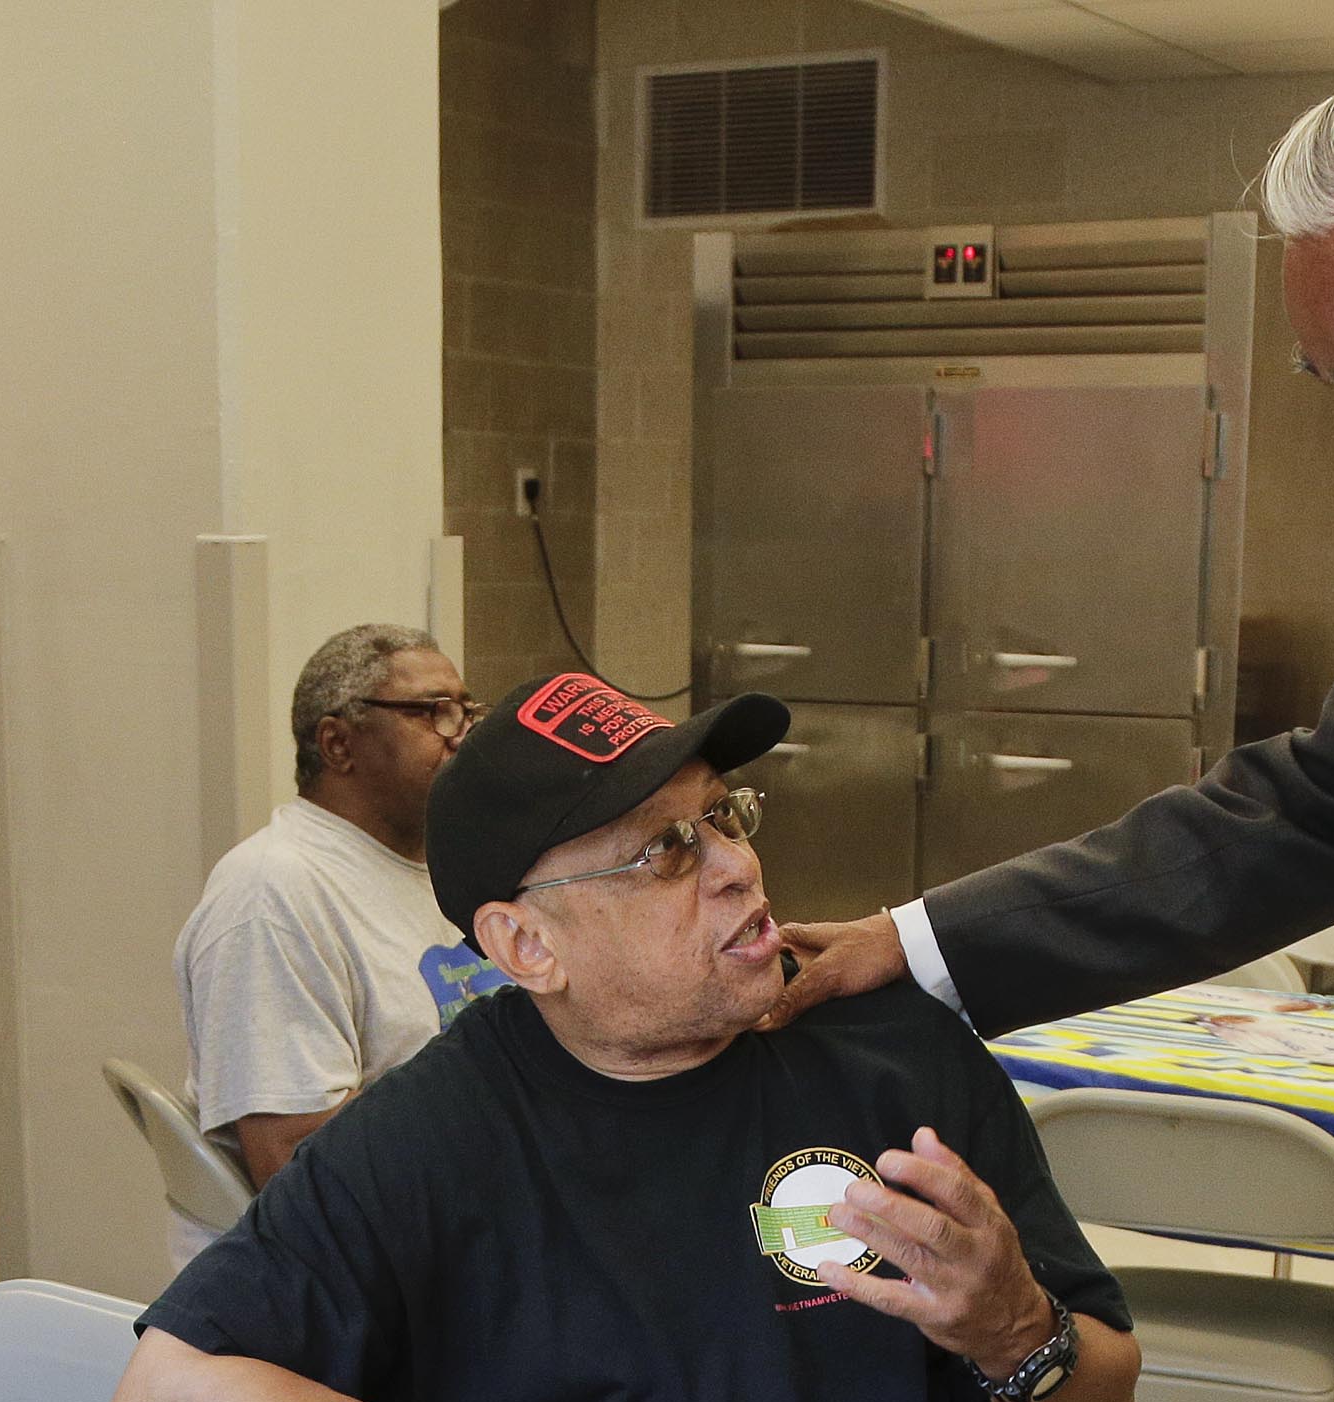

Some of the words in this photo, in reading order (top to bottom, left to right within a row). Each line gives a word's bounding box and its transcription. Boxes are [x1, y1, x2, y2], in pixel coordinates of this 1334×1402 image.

[576, 697, 607, 717] THIS
[578, 722, 596, 737] IS
[600, 714, 628, 735] FOR
[764, 1160, 796, 1203] FRIENDS
[796, 1153, 813, 1167] OF
[815, 1152, 840, 1165] THE
[842, 1156, 874, 1182] VIETN
[776, 1252, 820, 1281] VETERA
